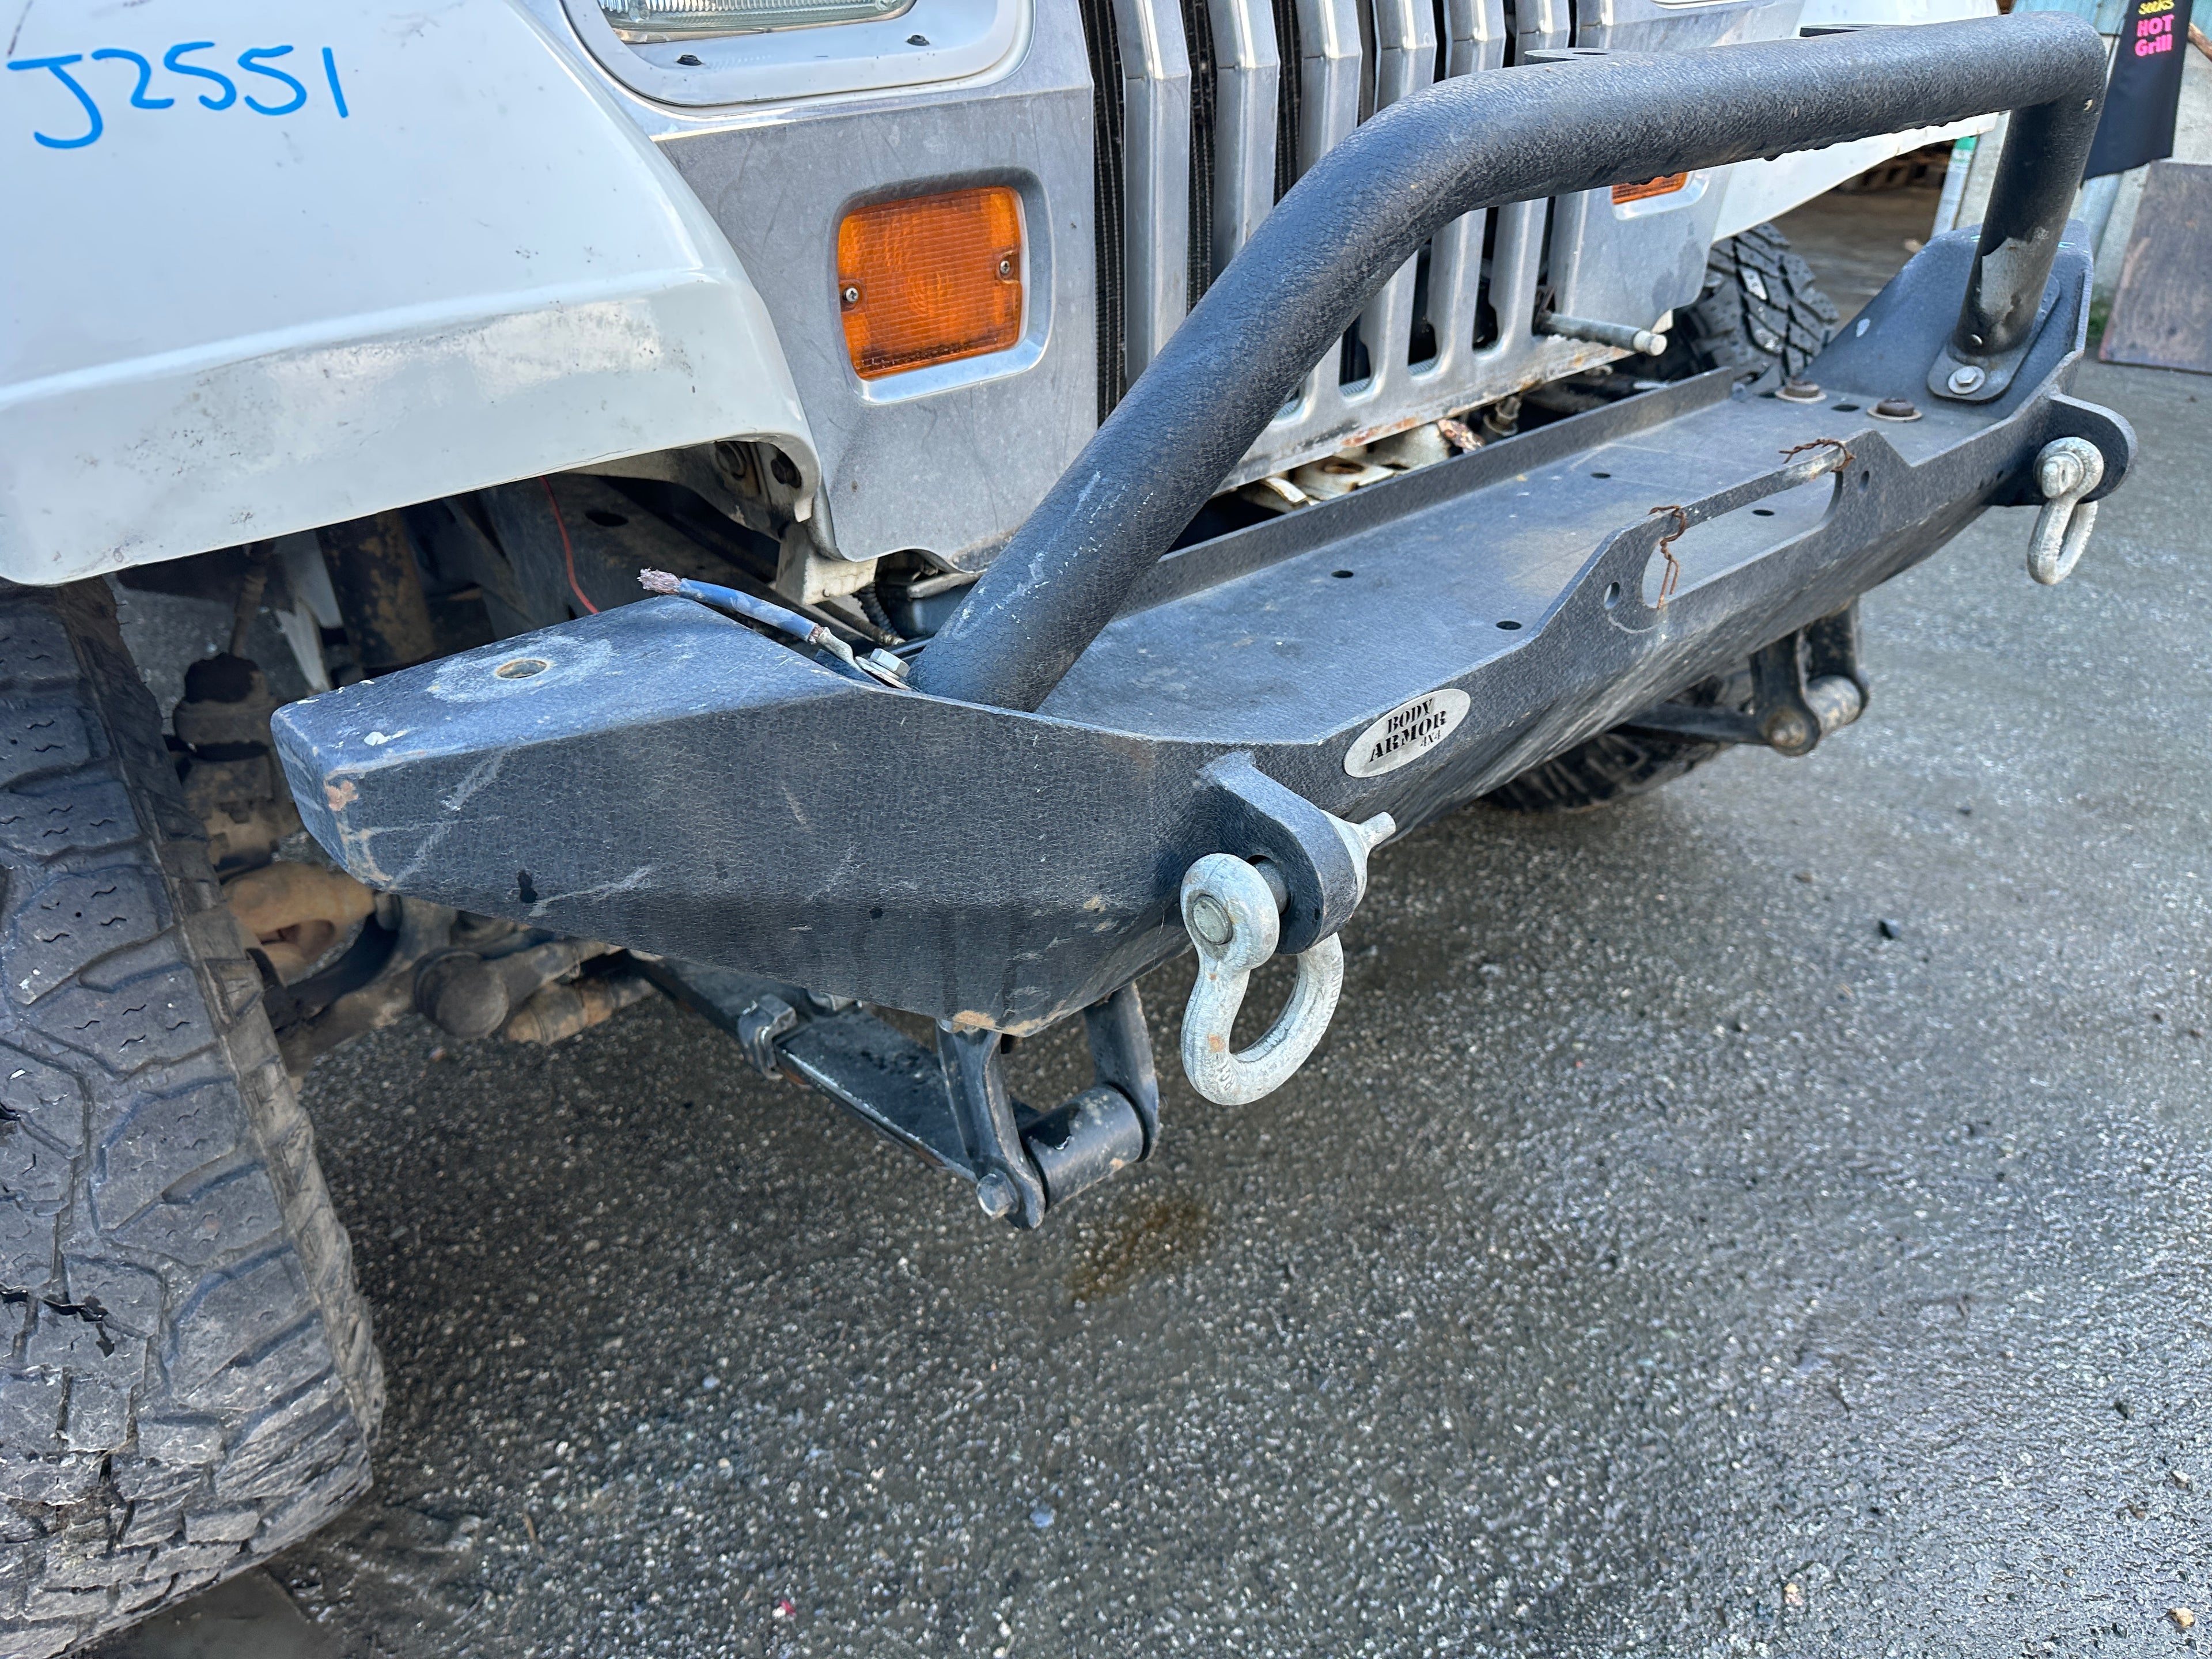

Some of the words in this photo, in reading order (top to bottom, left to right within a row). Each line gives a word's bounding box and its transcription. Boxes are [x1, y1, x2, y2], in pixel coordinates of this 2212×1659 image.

[2137, 14, 2175, 37] HOT
[2135, 34, 2173, 56] Grill
[7, 41, 349, 149] J2551
[1387, 698, 1433, 734] BODY
[1369, 710, 1447, 763] ARMOR
